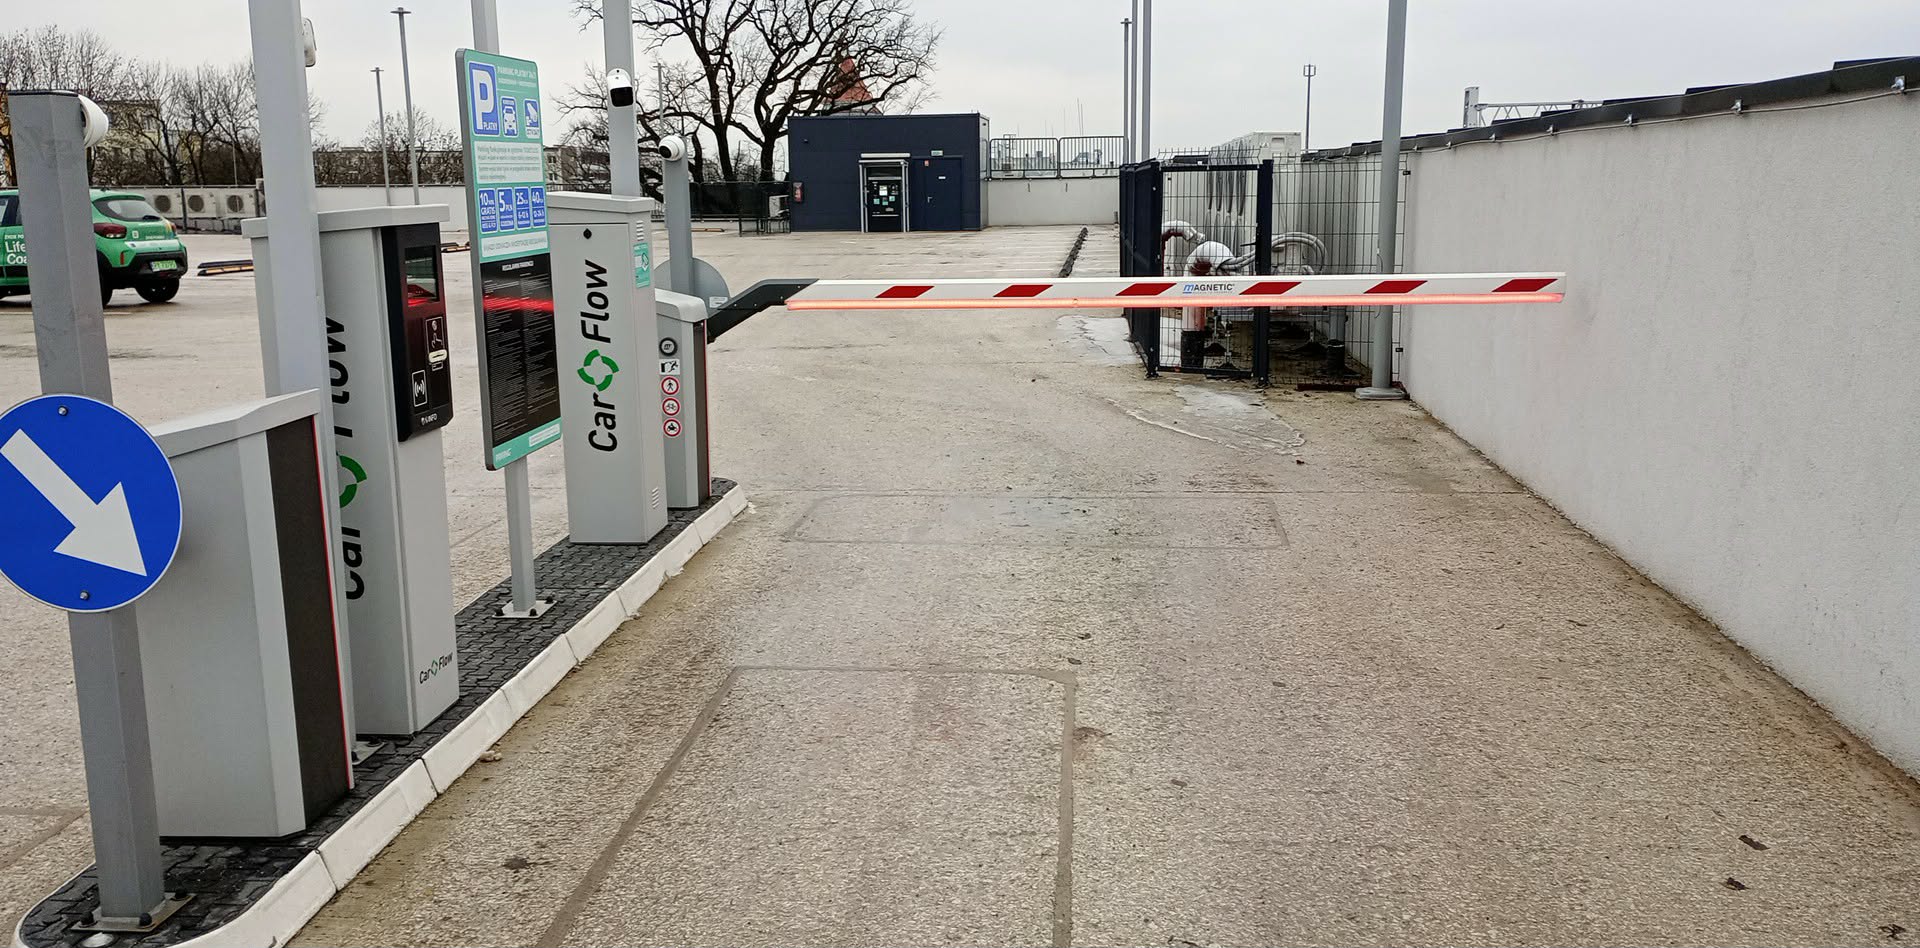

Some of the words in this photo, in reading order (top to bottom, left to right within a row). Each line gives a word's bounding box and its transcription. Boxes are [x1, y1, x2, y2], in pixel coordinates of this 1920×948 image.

[499, 192, 506, 212] 5
[5, 240, 26, 253] Life
[580, 259, 611, 343] Flow
[588, 392, 618, 452] Car
[419, 662, 431, 684] Car
[438, 651, 453, 671] Flow
